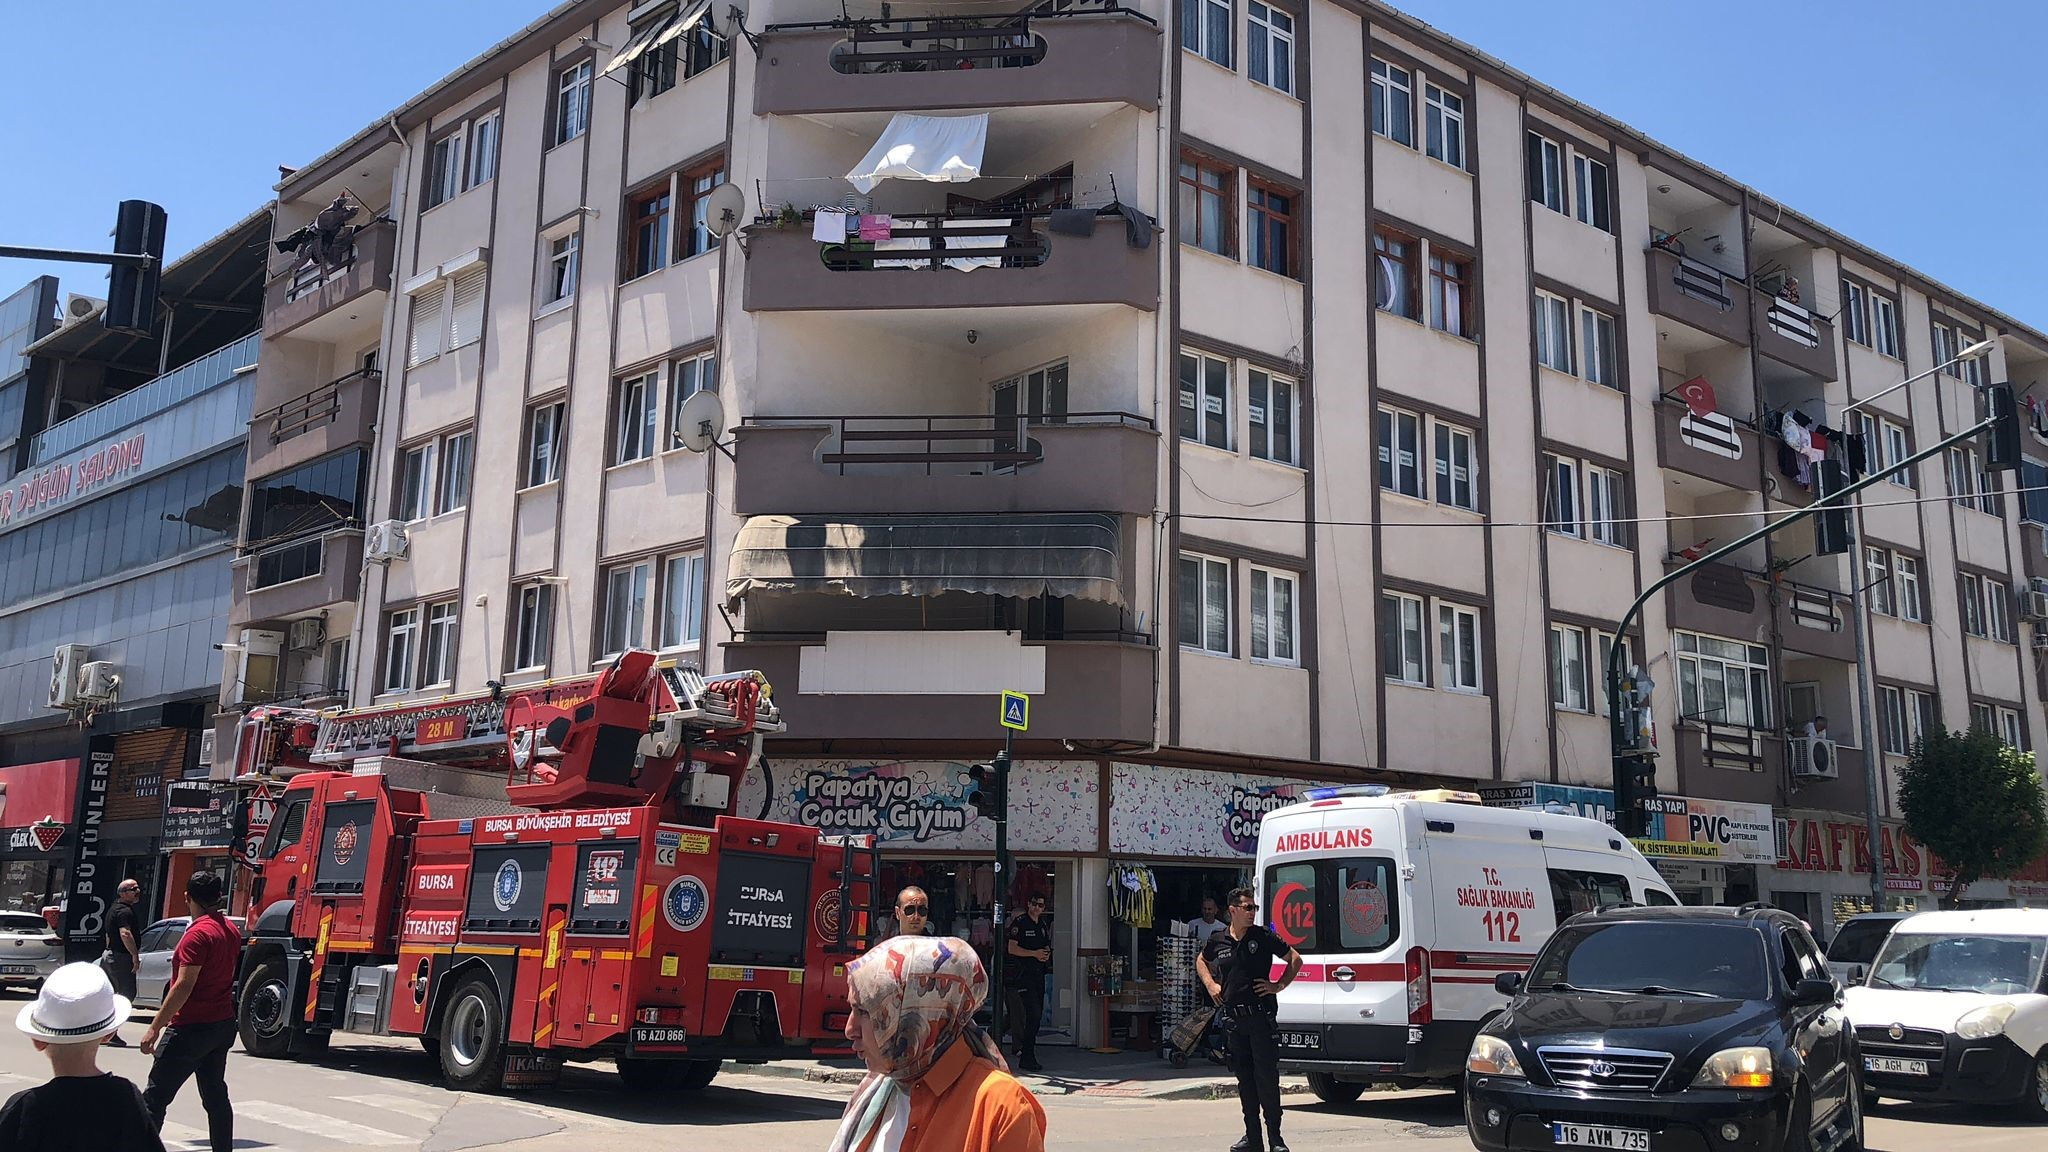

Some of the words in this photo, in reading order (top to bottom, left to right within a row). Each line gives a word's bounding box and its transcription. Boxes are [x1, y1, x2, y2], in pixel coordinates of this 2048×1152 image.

[16, 463, 73, 513] DÜĞÜN
[76, 432, 145, 490] SALONU
[427, 724, 441, 738] 28
[443, 721, 454, 736] M
[806, 773, 911, 808] Papatya
[1509, 787, 1533, 798] YAPI
[1664, 801, 1686, 814] YAPI
[76, 762, 109, 894] BÜTÜNLER
[485, 819, 513, 833] BURSA
[516, 813, 572, 832] BÜYÜKŞEHİR
[575, 810, 632, 828] BELEDİYESİ
[888, 802, 964, 840] Giyim
[1689, 814, 1731, 844] PVC
[1275, 828, 1373, 853] AMBULANS
[1647, 842, 1690, 855] SİSTEMLERİ
[1776, 818, 1921, 877] KAFKAS
[418, 874, 454, 890] BURSA
[1482, 867, 1502, 887] T.C.
[1457, 884, 1490, 908] SAĞLIK
[1490, 887, 1536, 910] BAKANLIĞI
[403, 916, 458, 936] İTFAİYESİ
[1284, 901, 1315, 929] 112
[1482, 910, 1521, 943] 112
[637, 1029, 647, 1041] 16
[648, 1029, 666, 1041] AZD
[667, 1029, 684, 1041] 866
[1281, 1032, 1289, 1044] 16
[1290, 1032, 1302, 1045] BD
[1304, 1034, 1319, 1046] 847
[1592, 1065, 1612, 1074] KIA
[1871, 1058, 1880, 1070] 16
[1884, 1060, 1902, 1072] AGH
[1909, 1060, 1926, 1073] 421
[1563, 1126, 1579, 1143] 16
[1587, 1127, 1613, 1147] AVM
[1620, 1131, 1648, 1150] 735
